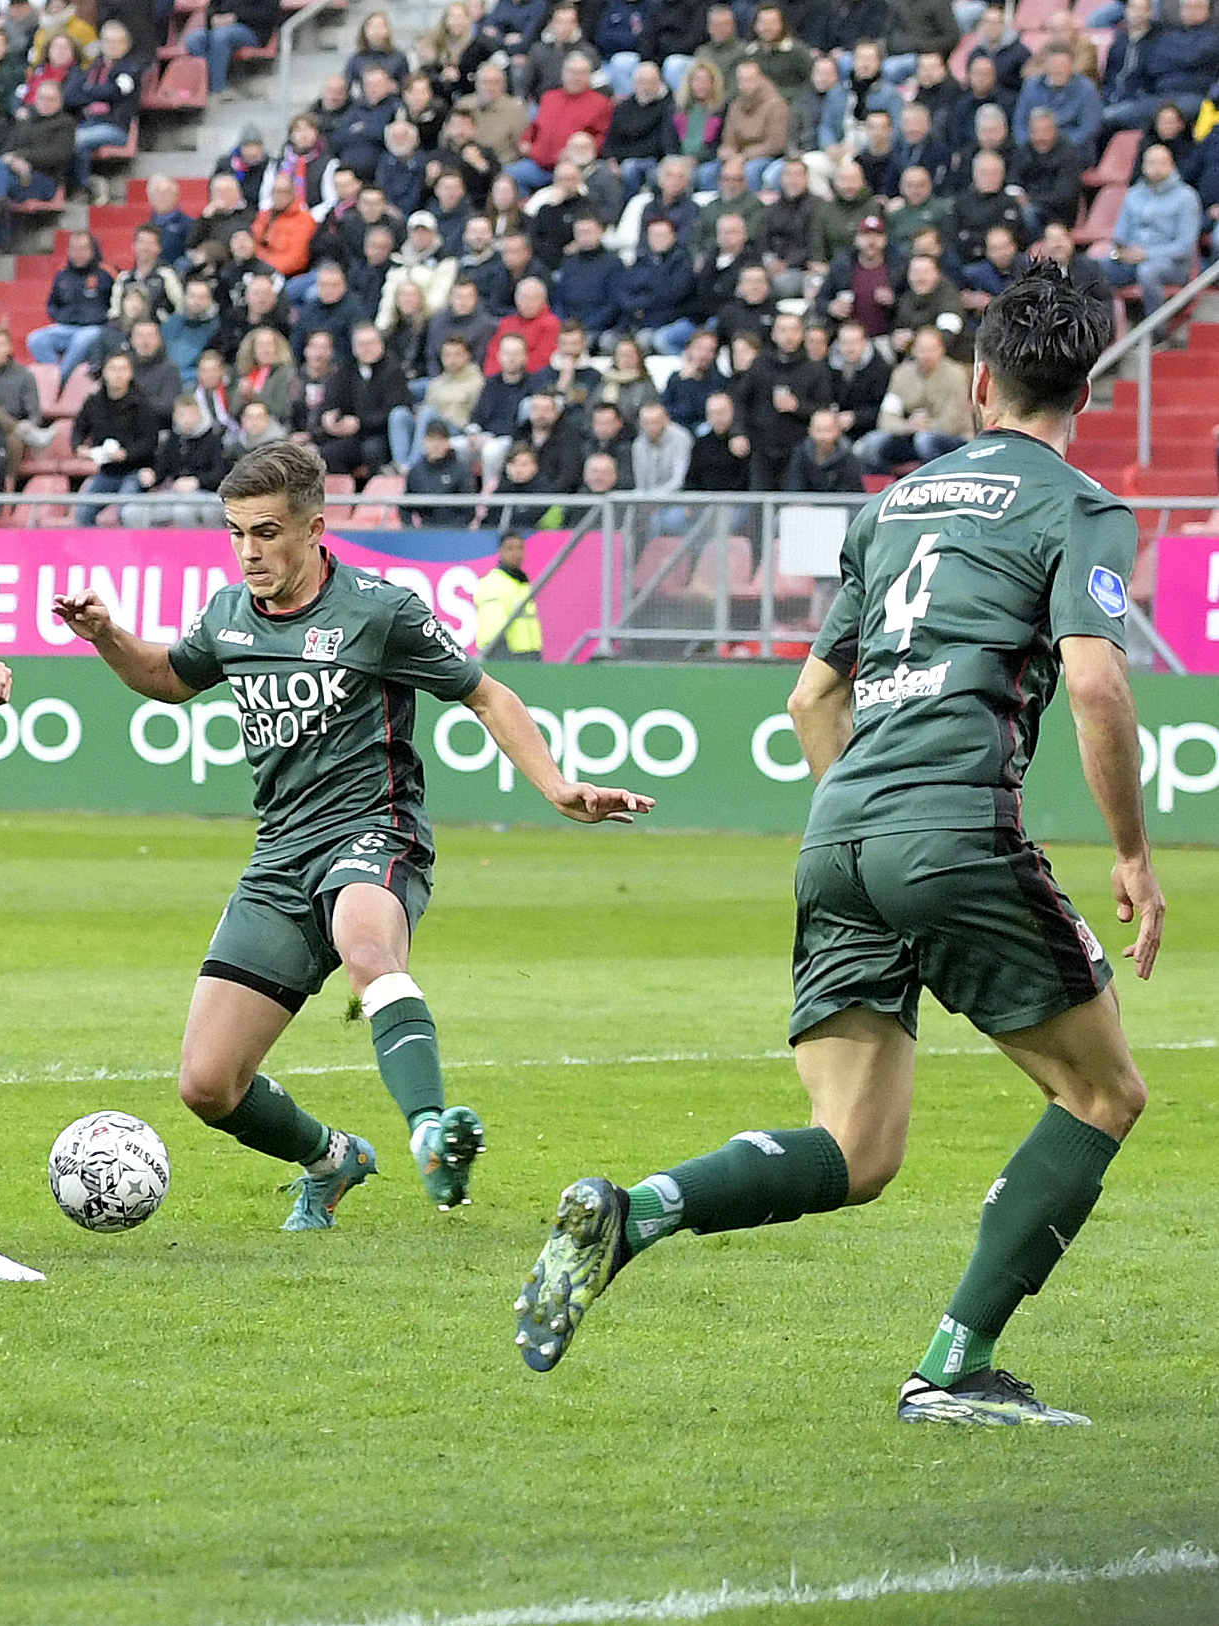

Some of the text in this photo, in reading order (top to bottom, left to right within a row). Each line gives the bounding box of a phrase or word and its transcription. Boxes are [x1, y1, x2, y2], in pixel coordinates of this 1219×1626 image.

[889, 482, 1017, 510] NASWERKT!
[883, 533, 941, 653] 4
[244, 668, 349, 711] KLOK
